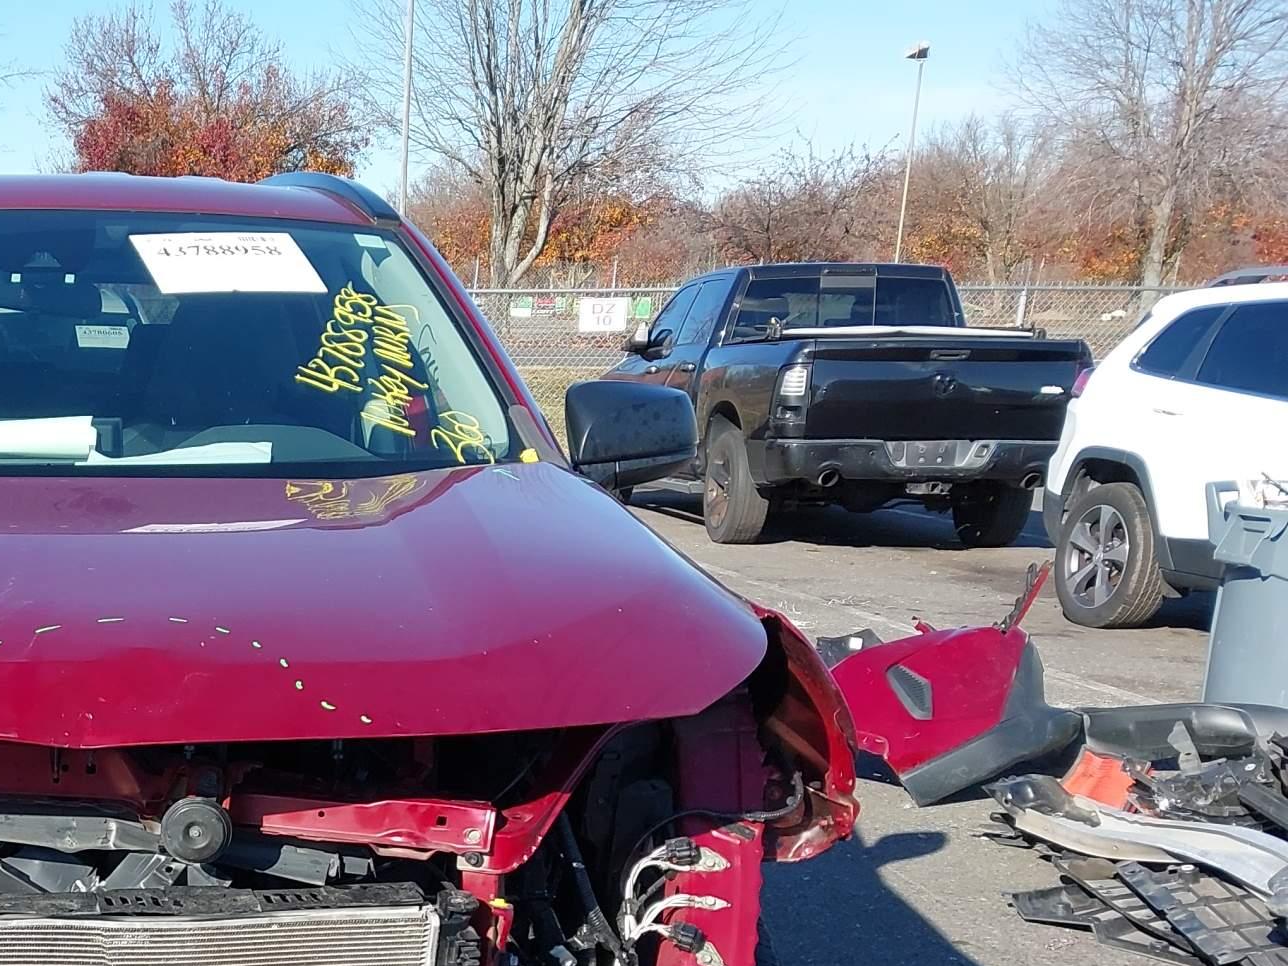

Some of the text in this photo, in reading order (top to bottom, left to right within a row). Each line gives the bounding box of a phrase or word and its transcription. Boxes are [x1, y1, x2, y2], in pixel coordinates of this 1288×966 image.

[591, 303, 617, 315] DZ
[595, 316, 612, 326] 10
[294, 281, 378, 392] 43788958
